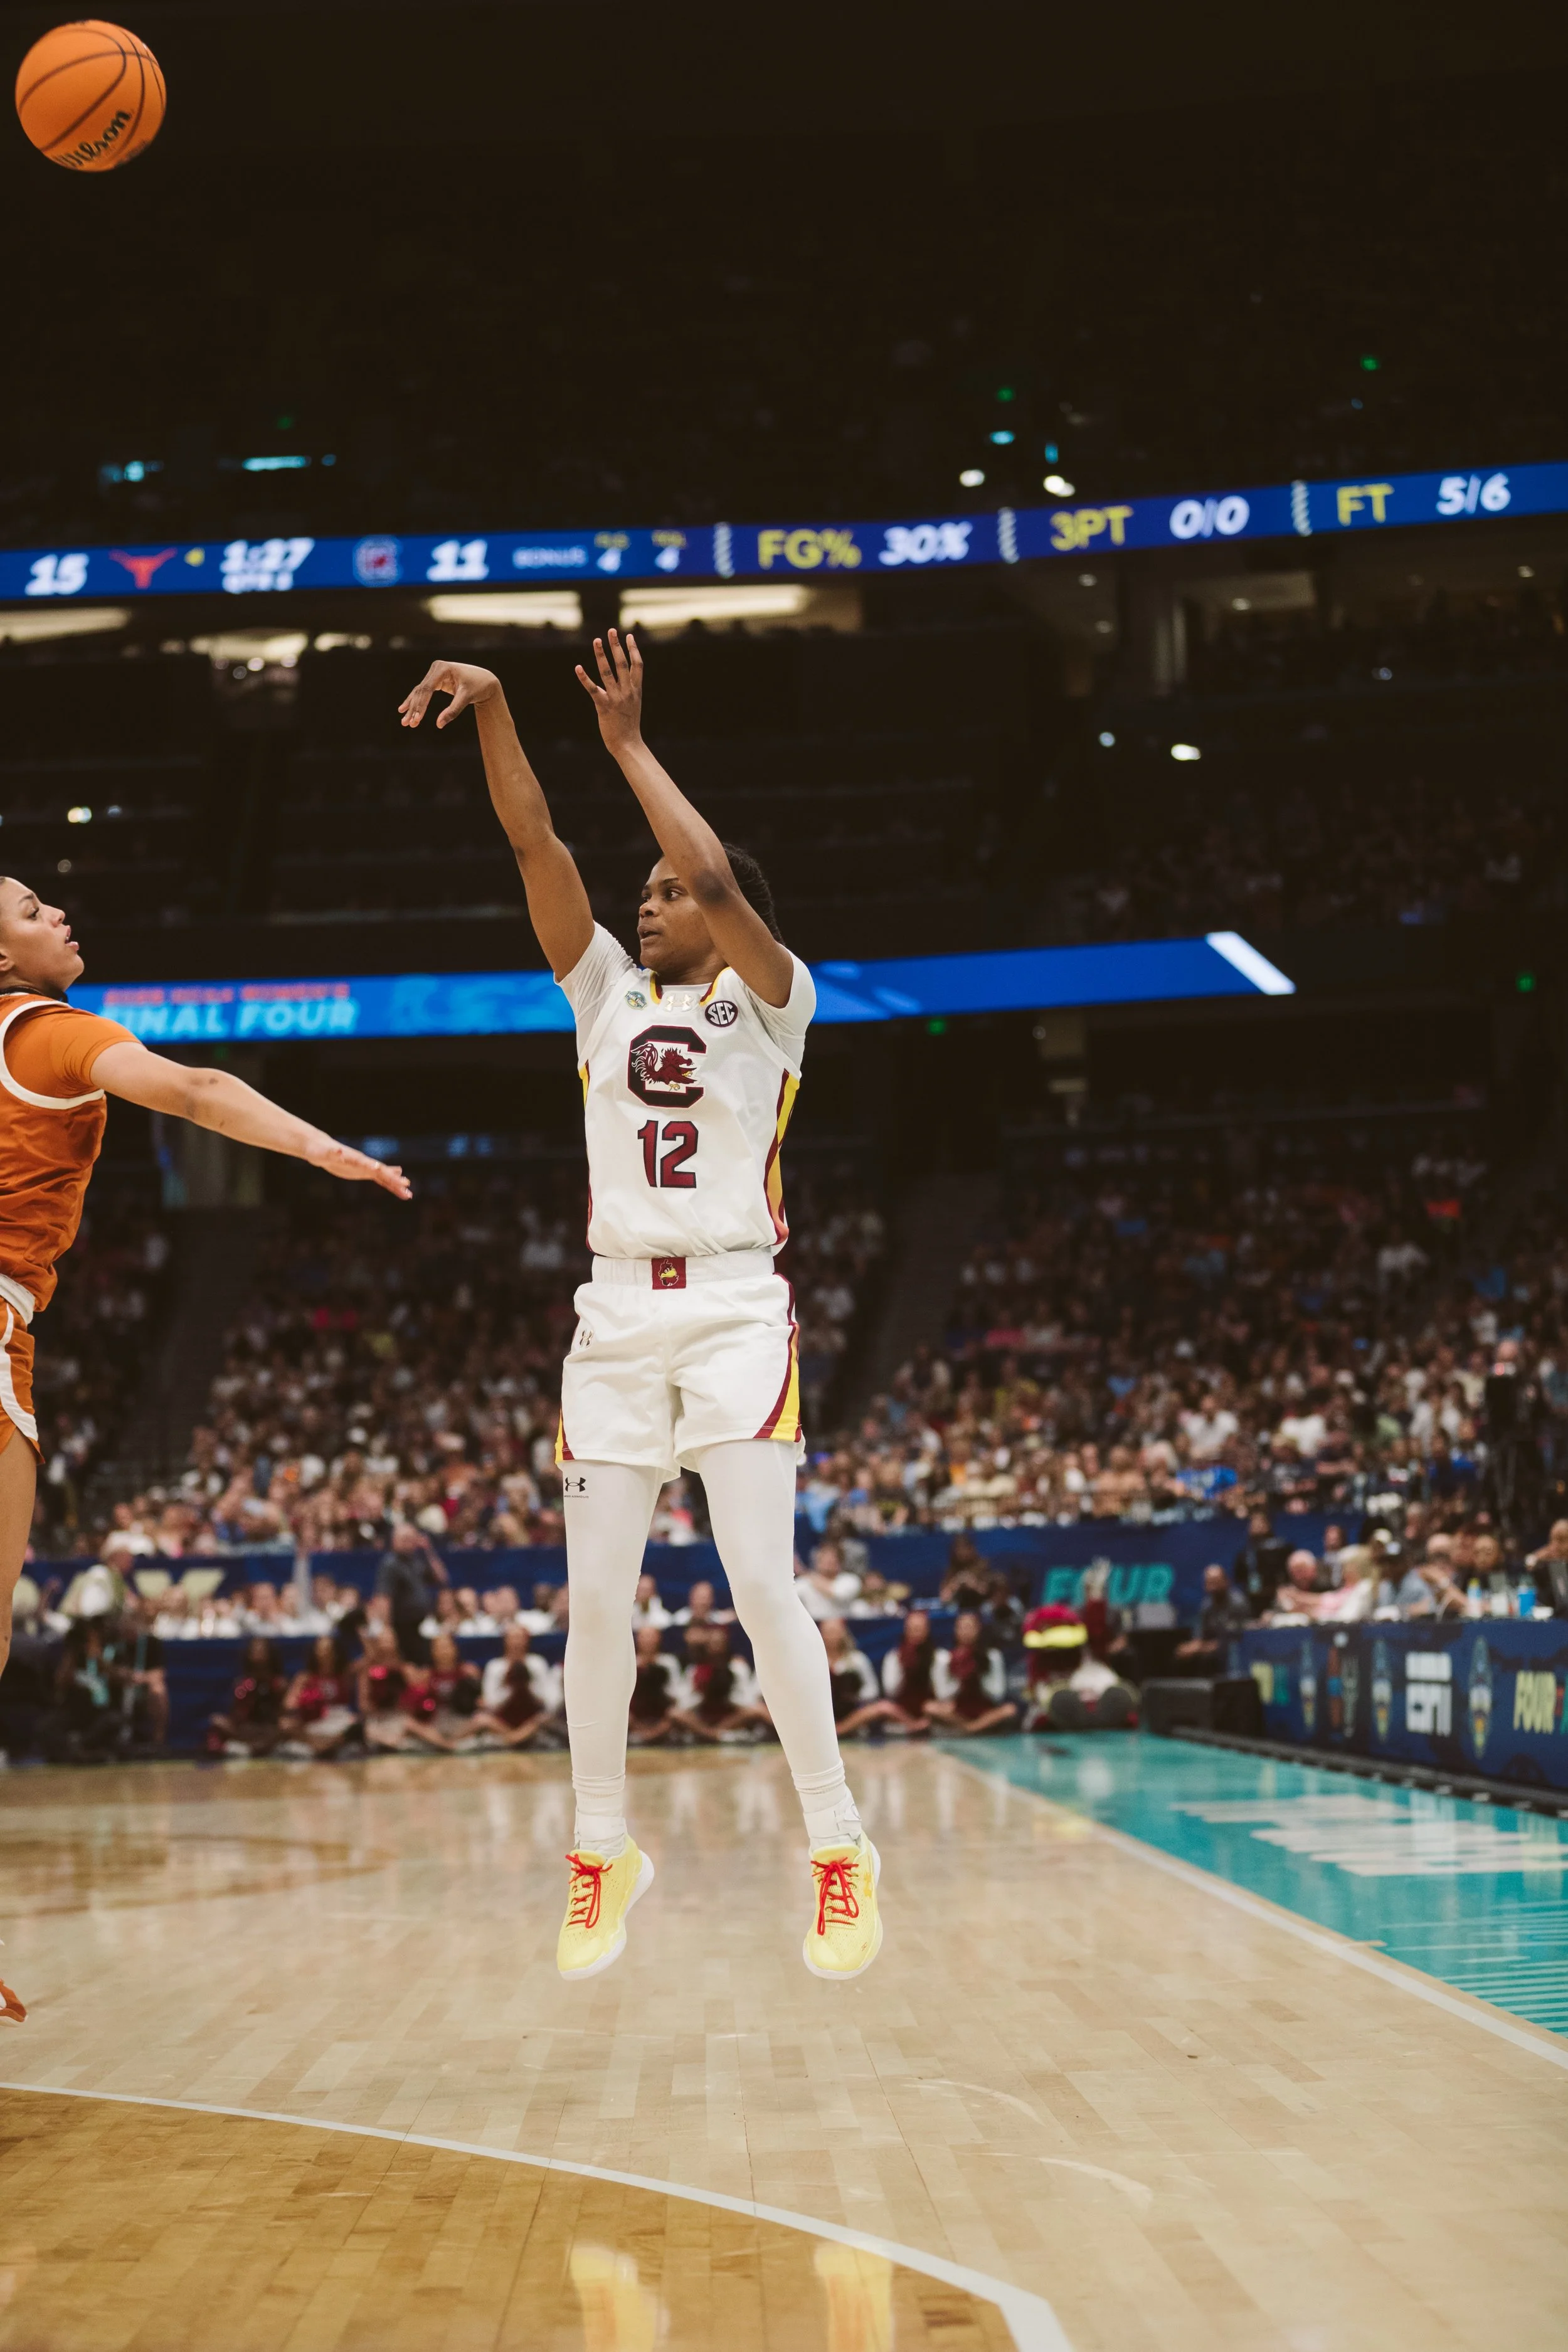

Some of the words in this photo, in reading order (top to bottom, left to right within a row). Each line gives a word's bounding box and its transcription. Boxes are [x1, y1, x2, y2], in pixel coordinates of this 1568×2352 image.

[1337, 483, 1394, 526] FT
[1437, 473, 1511, 516] 5/6
[1050, 505, 1132, 551] 3PT
[1169, 495, 1249, 539] 0/0
[220, 538, 314, 573] 1:27
[427, 540, 488, 582] 11
[758, 529, 861, 569] FG%
[879, 521, 973, 567] 30%
[26, 553, 88, 595] 15
[237, 1000, 358, 1037] FOUR
[707, 1002, 735, 1025] SEC
[637, 1120, 698, 1188] 12
